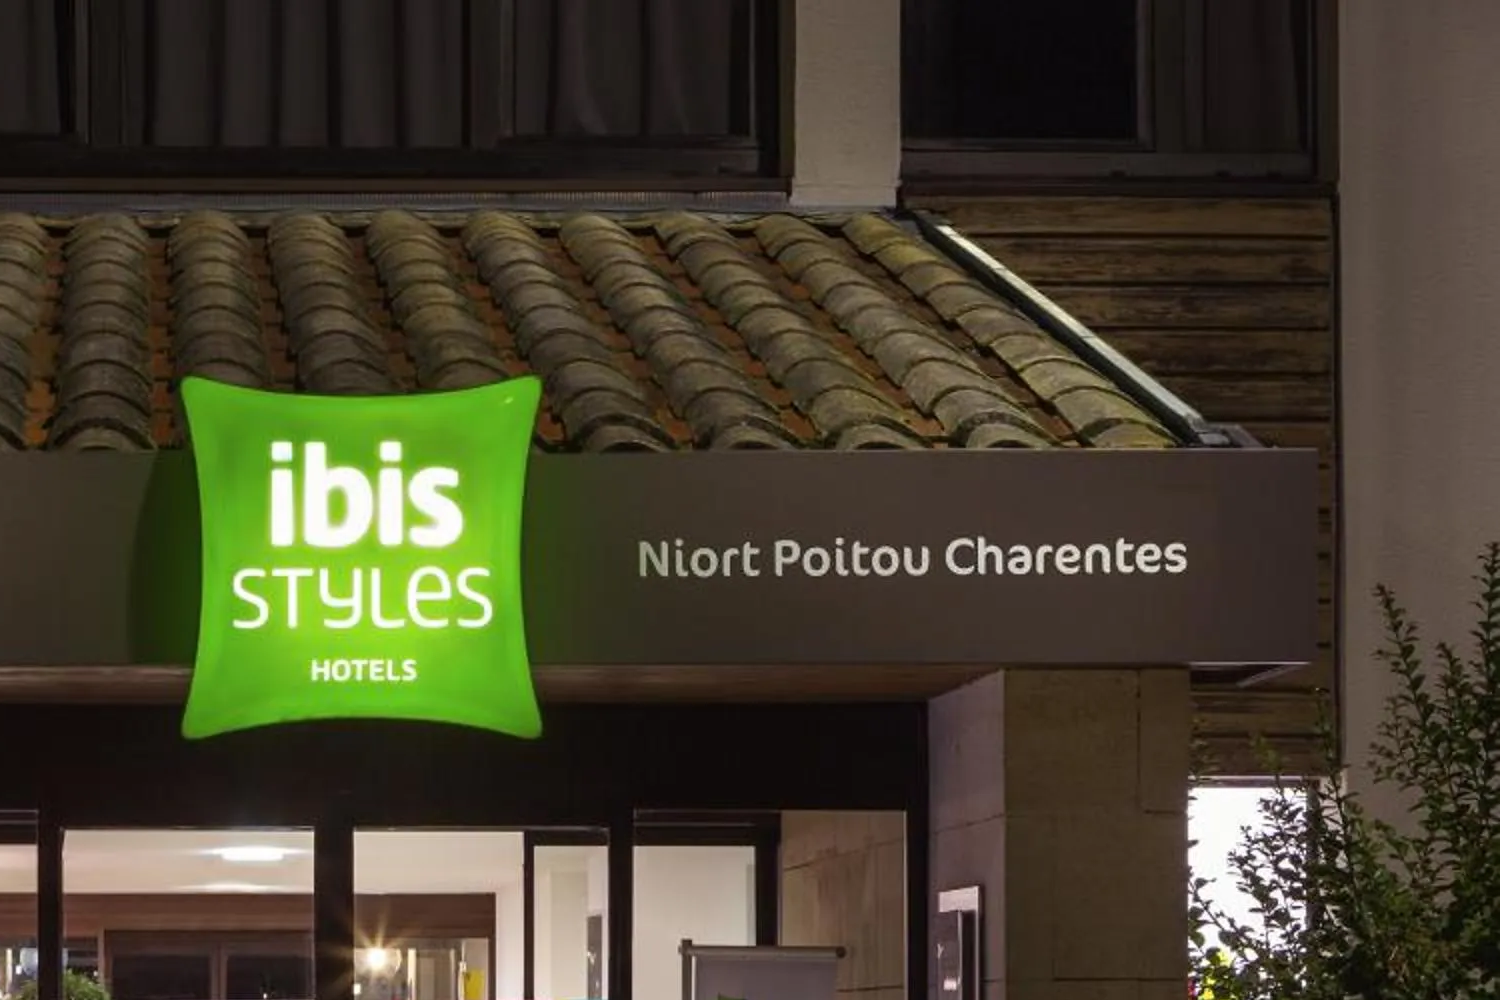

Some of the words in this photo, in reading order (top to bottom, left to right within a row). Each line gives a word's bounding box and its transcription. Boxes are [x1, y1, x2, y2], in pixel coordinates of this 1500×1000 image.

[269, 440, 464, 549] ibis
[638, 538, 761, 578] Niort
[773, 537, 931, 577] Poitou
[945, 536, 1188, 575] Charentes
[310, 658, 418, 683] HOTELS
